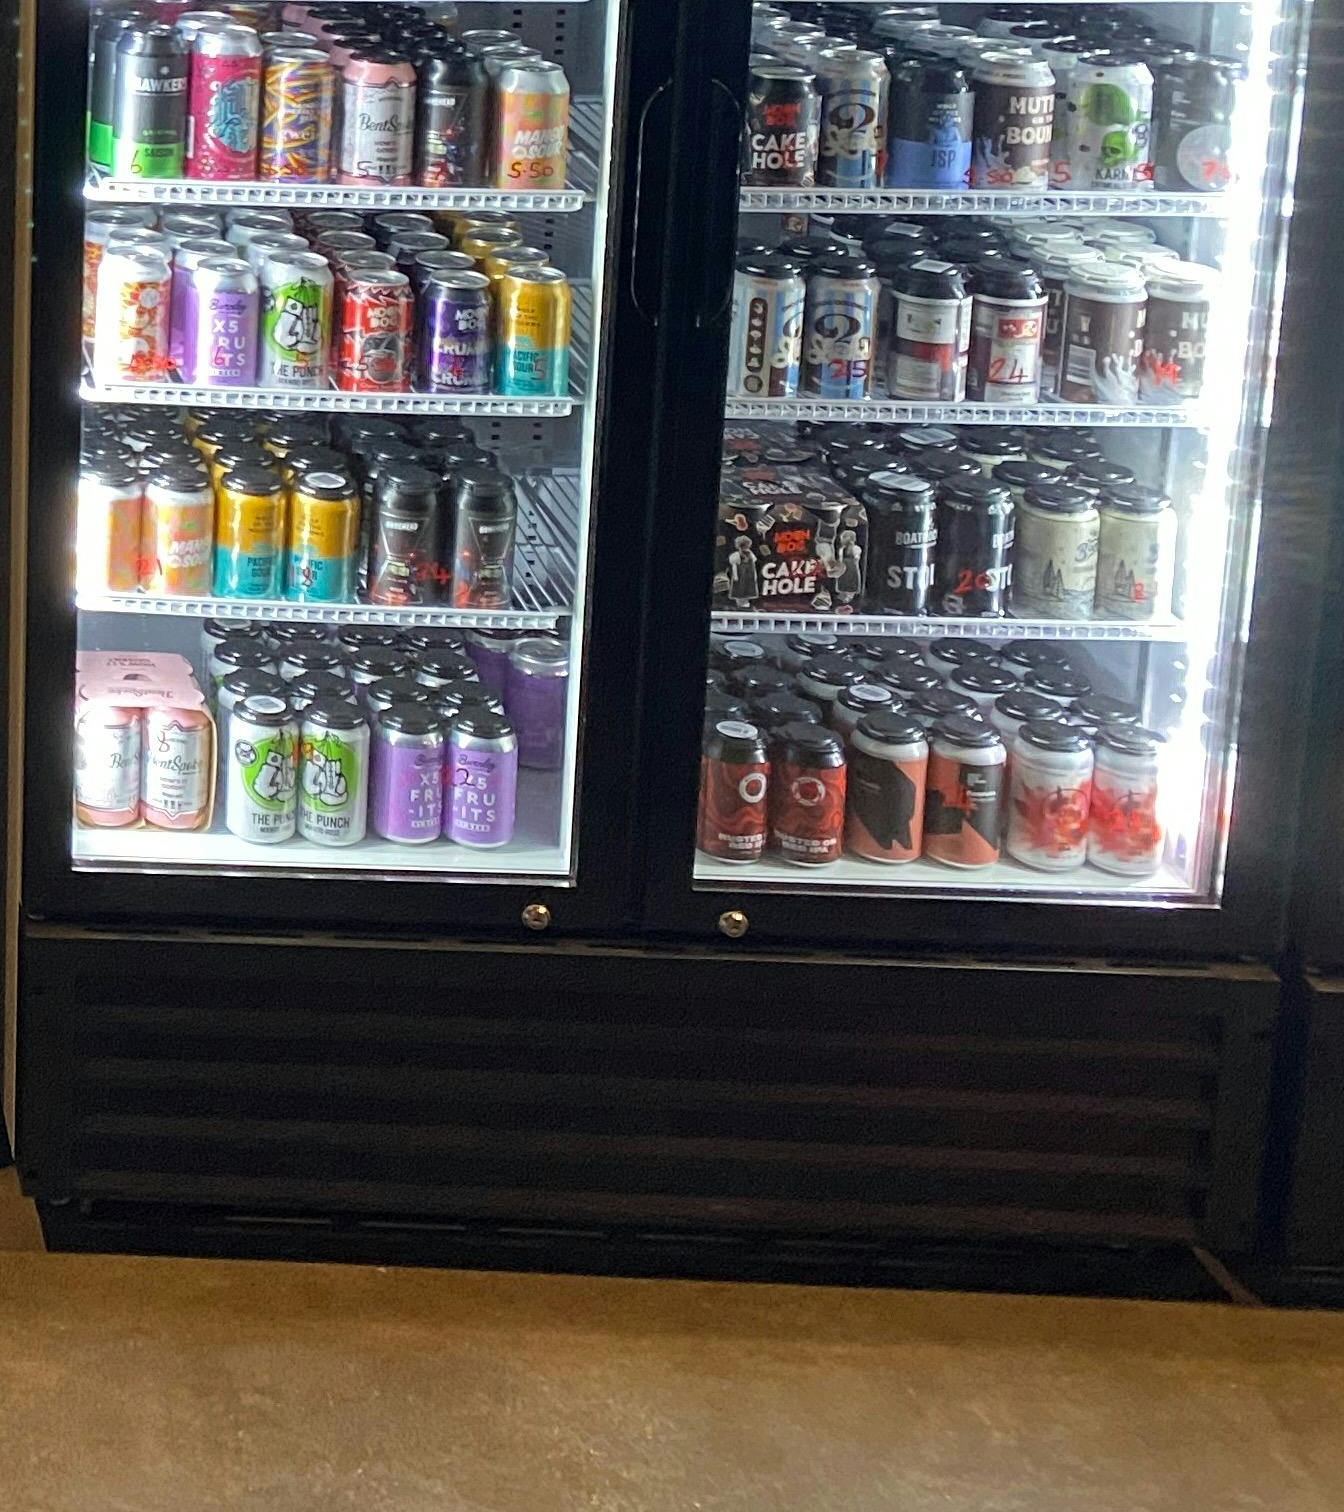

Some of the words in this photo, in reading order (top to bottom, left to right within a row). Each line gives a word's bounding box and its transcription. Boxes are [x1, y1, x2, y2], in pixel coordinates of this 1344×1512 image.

[751, 132, 807, 151] CAKE
[751, 150, 807, 170] HOLE
[1051, 160, 1071, 183] 5
[988, 357, 1029, 383] 24
[761, 558, 818, 579] CAKE
[761, 576, 817, 596] HOLE
[454, 791, 496, 806] FRU
[252, 813, 270, 825] THE
[316, 815, 351, 830] PUNCH
